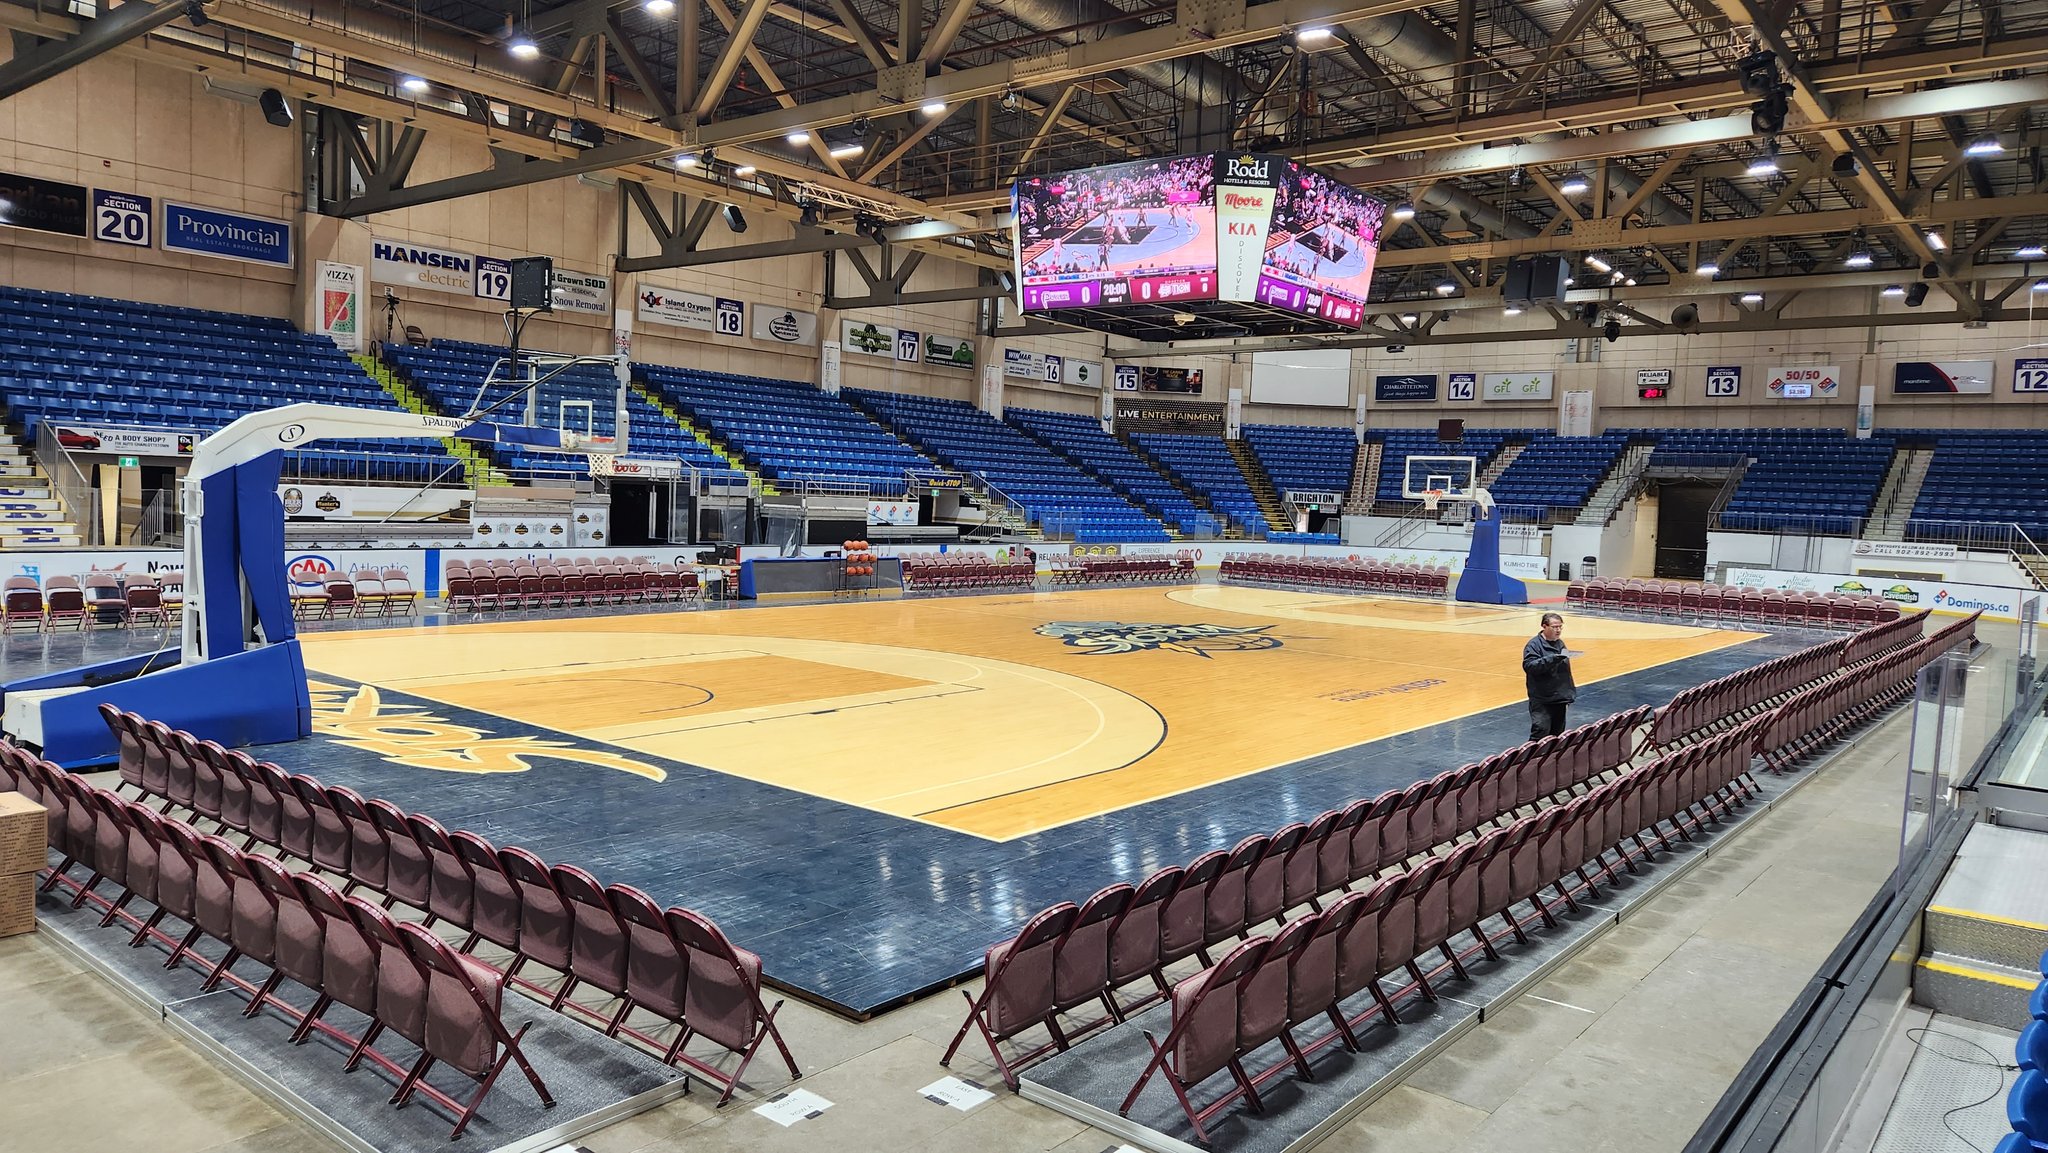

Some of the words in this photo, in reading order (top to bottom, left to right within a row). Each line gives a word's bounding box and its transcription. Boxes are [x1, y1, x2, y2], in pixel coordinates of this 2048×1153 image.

[1227, 159, 1269, 179] Rodd
[104, 199, 141, 211] SECTION
[1225, 193, 1263, 209] Moore
[102, 210, 143, 241] 20
[178, 214, 280, 247] Provincial
[1228, 223, 1256, 236] KIA
[186, 236, 203, 244] REAL
[206, 239, 230, 248] ESTATE
[233, 243, 271, 254] BROKERAGE
[374, 243, 470, 273] HANSEN
[482, 263, 508, 273] SECTION
[1235, 240, 1244, 299] DISCOVER
[326, 270, 354, 281] VIZZY
[418, 269, 470, 289] electric
[557, 273, 583, 286] Grown
[584, 278, 606, 289] SOD
[482, 273, 508, 297] 19
[1103, 283, 1126, 295] 20:00
[555, 296, 574, 306] Snow
[576, 299, 606, 311] Removal
[665, 298, 685, 307] Island
[687, 302, 711, 312] Oxygen
[720, 303, 739, 311] SECTION
[720, 312, 739, 332] 18
[850, 328, 892, 342] Charlottetown
[875, 342, 892, 352] Metal
[901, 341, 916, 359] 17
[1008, 351, 1031, 360] WINMAR
[1047, 365, 1057, 380] 16
[1786, 371, 1820, 380] 50/50
[2020, 370, 2048, 389] 12
[1118, 374, 1135, 388] 15
[1494, 378, 1511, 393] GFL
[1522, 377, 1540, 392] GFL
[1711, 377, 1734, 393] 13
[1452, 383, 1470, 397] 14
[422, 416, 467, 429] SPALDING
[1118, 410, 1139, 418] LIVE
[1142, 411, 1220, 421] ENTERTAINMENT
[94, 430, 113, 442] NEED
[1293, 493, 1334, 503] BRIGHTON
[291, 559, 327, 575] CAA
[349, 562, 409, 576] Atlantic
[1835, 588, 1871, 596] Cavendish
[1883, 590, 1918, 601] Cavendish
[1948, 596, 2009, 613] Dominos.ca
